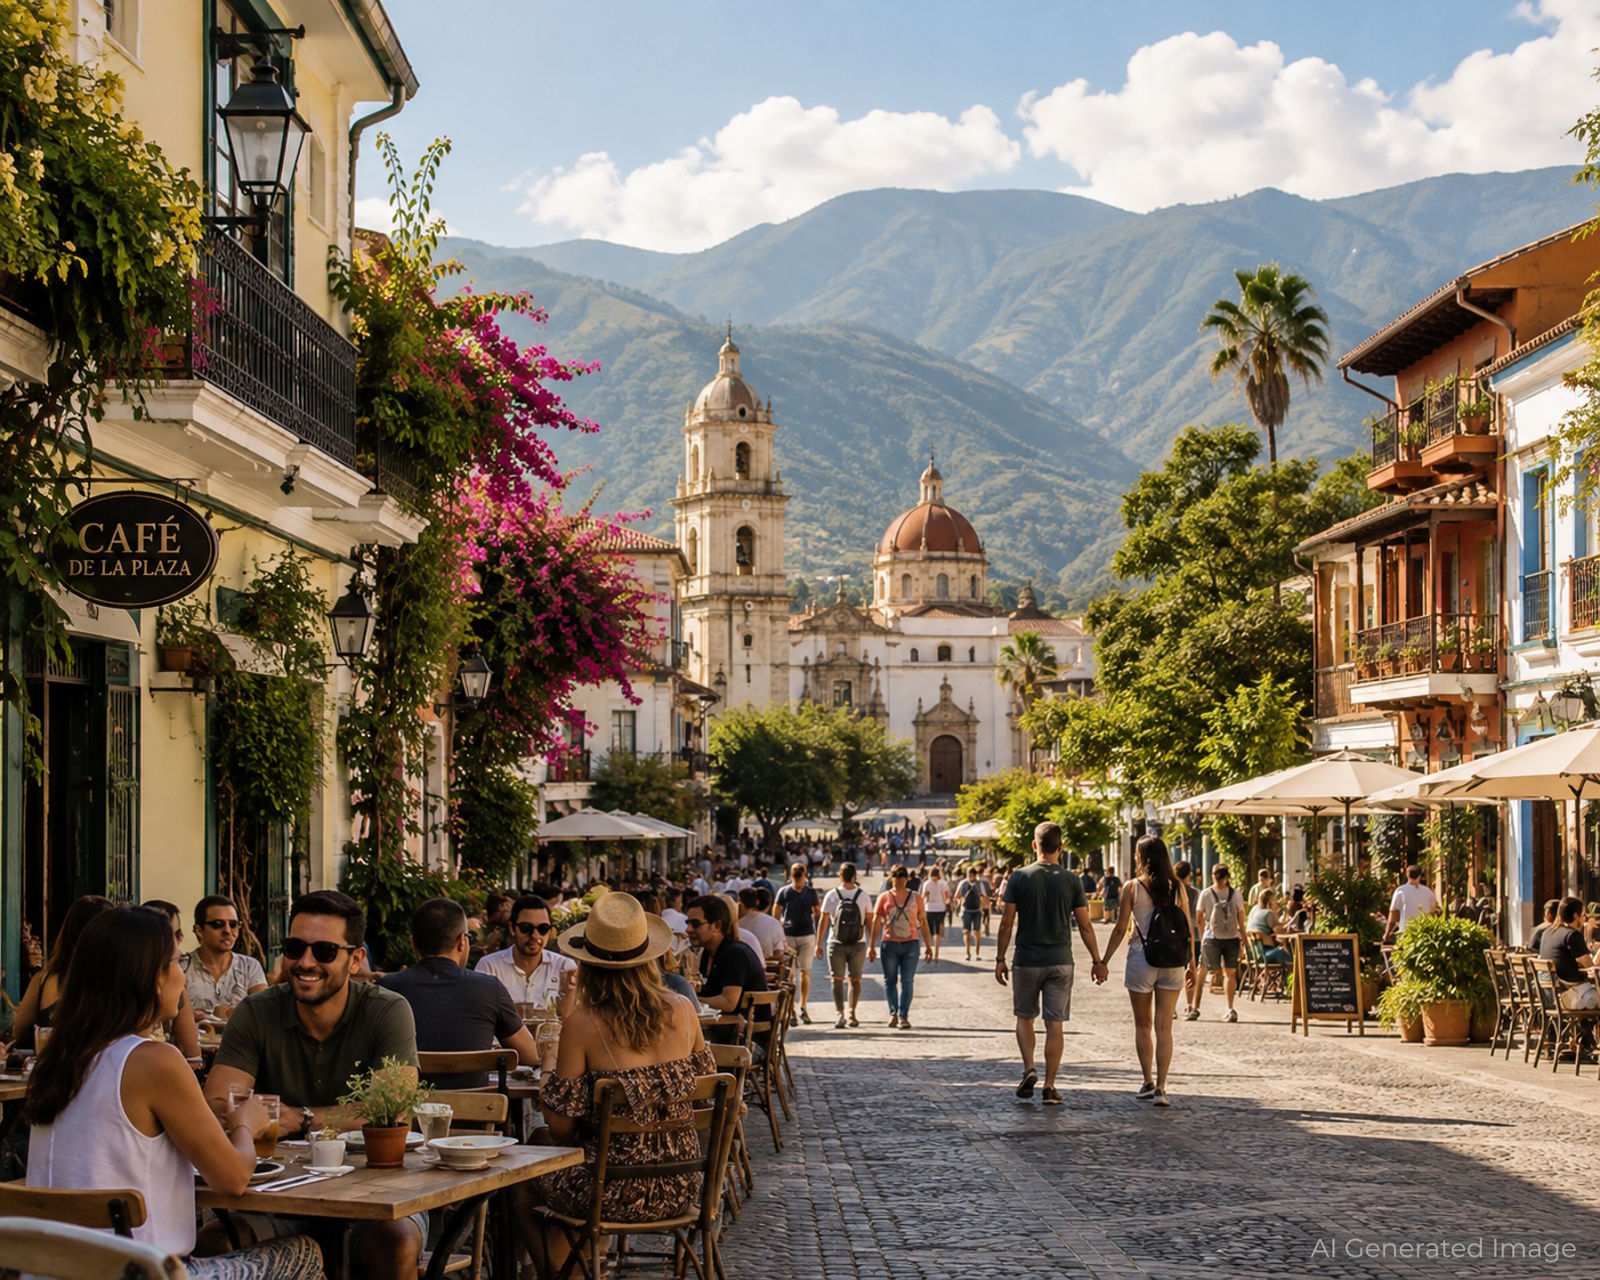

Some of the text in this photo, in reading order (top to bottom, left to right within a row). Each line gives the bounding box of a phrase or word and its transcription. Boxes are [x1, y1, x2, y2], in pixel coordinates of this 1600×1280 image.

[78, 515, 181, 554] CAFÉ
[69, 559, 192, 576] DE LA PLAZA
